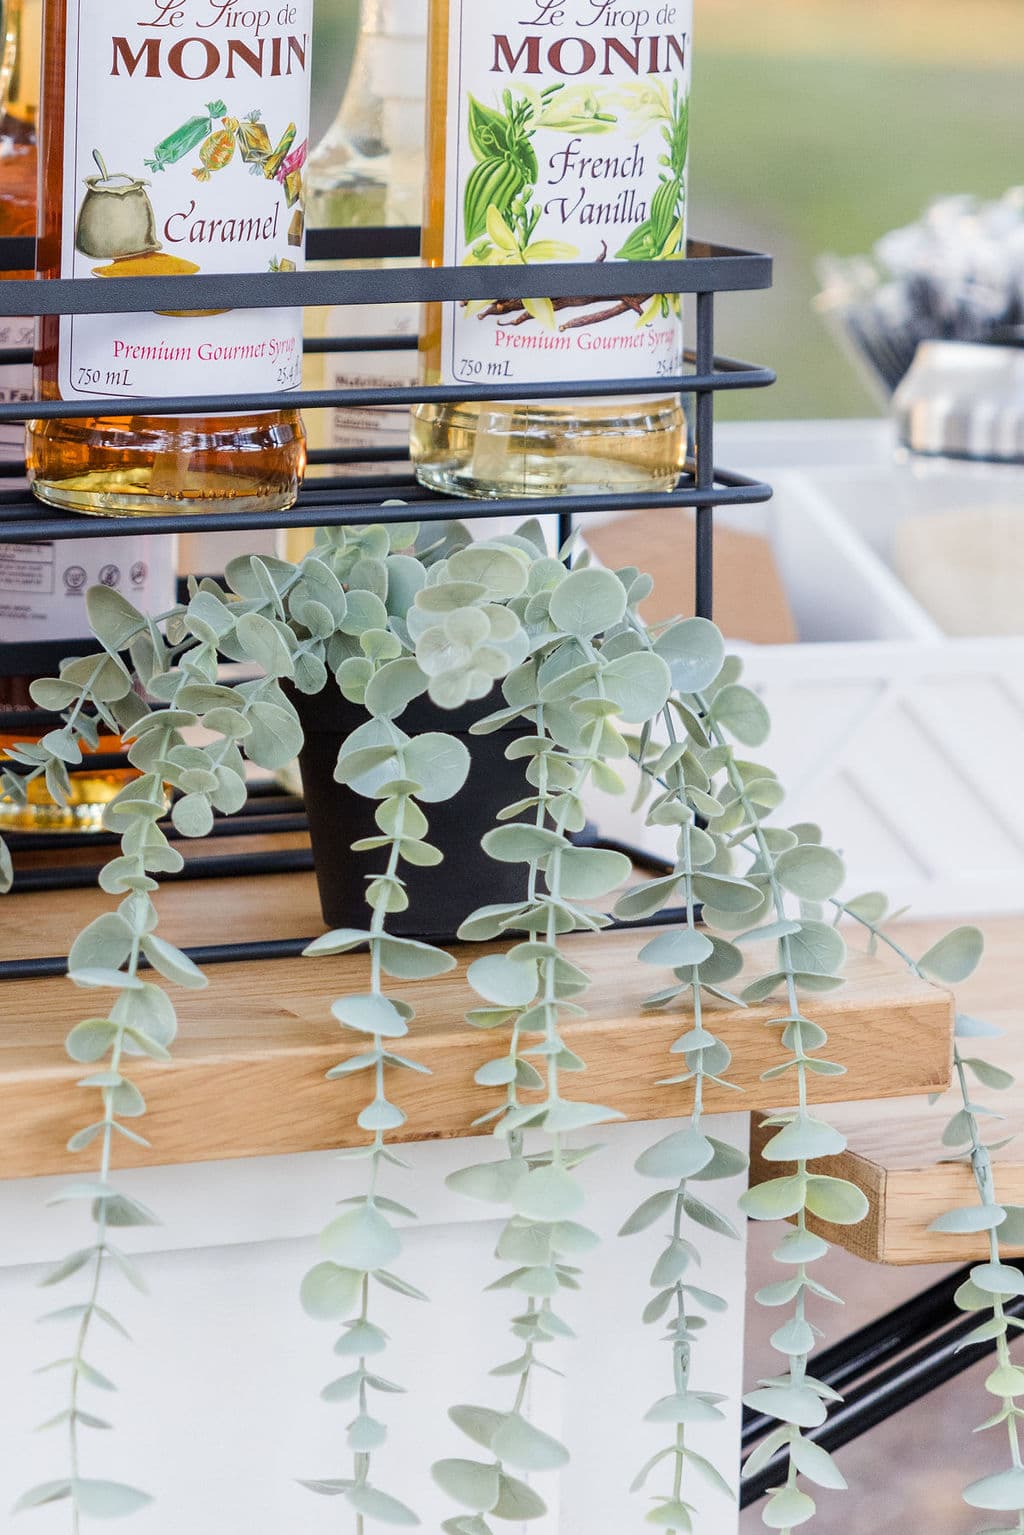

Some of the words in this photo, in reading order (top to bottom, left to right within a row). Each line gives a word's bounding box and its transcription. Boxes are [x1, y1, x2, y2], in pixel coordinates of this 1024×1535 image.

[276, 4, 297, 26] de
[656, 4, 676, 25] de
[109, 33, 307, 81] MONIN
[489, 32, 687, 76] MONIN
[547, 138, 645, 185] French
[543, 187, 648, 225] Vanilla
[163, 200, 280, 244] Caramel
[113, 339, 192, 362] Premium
[197, 340, 266, 362] Gourmet
[495, 329, 571, 350] Premium
[577, 332, 645, 351] Gourmet
[78, 368, 101, 386] 750
[105, 368, 134, 387] mL
[460, 358, 483, 377] 750
[487, 360, 514, 377] mL
